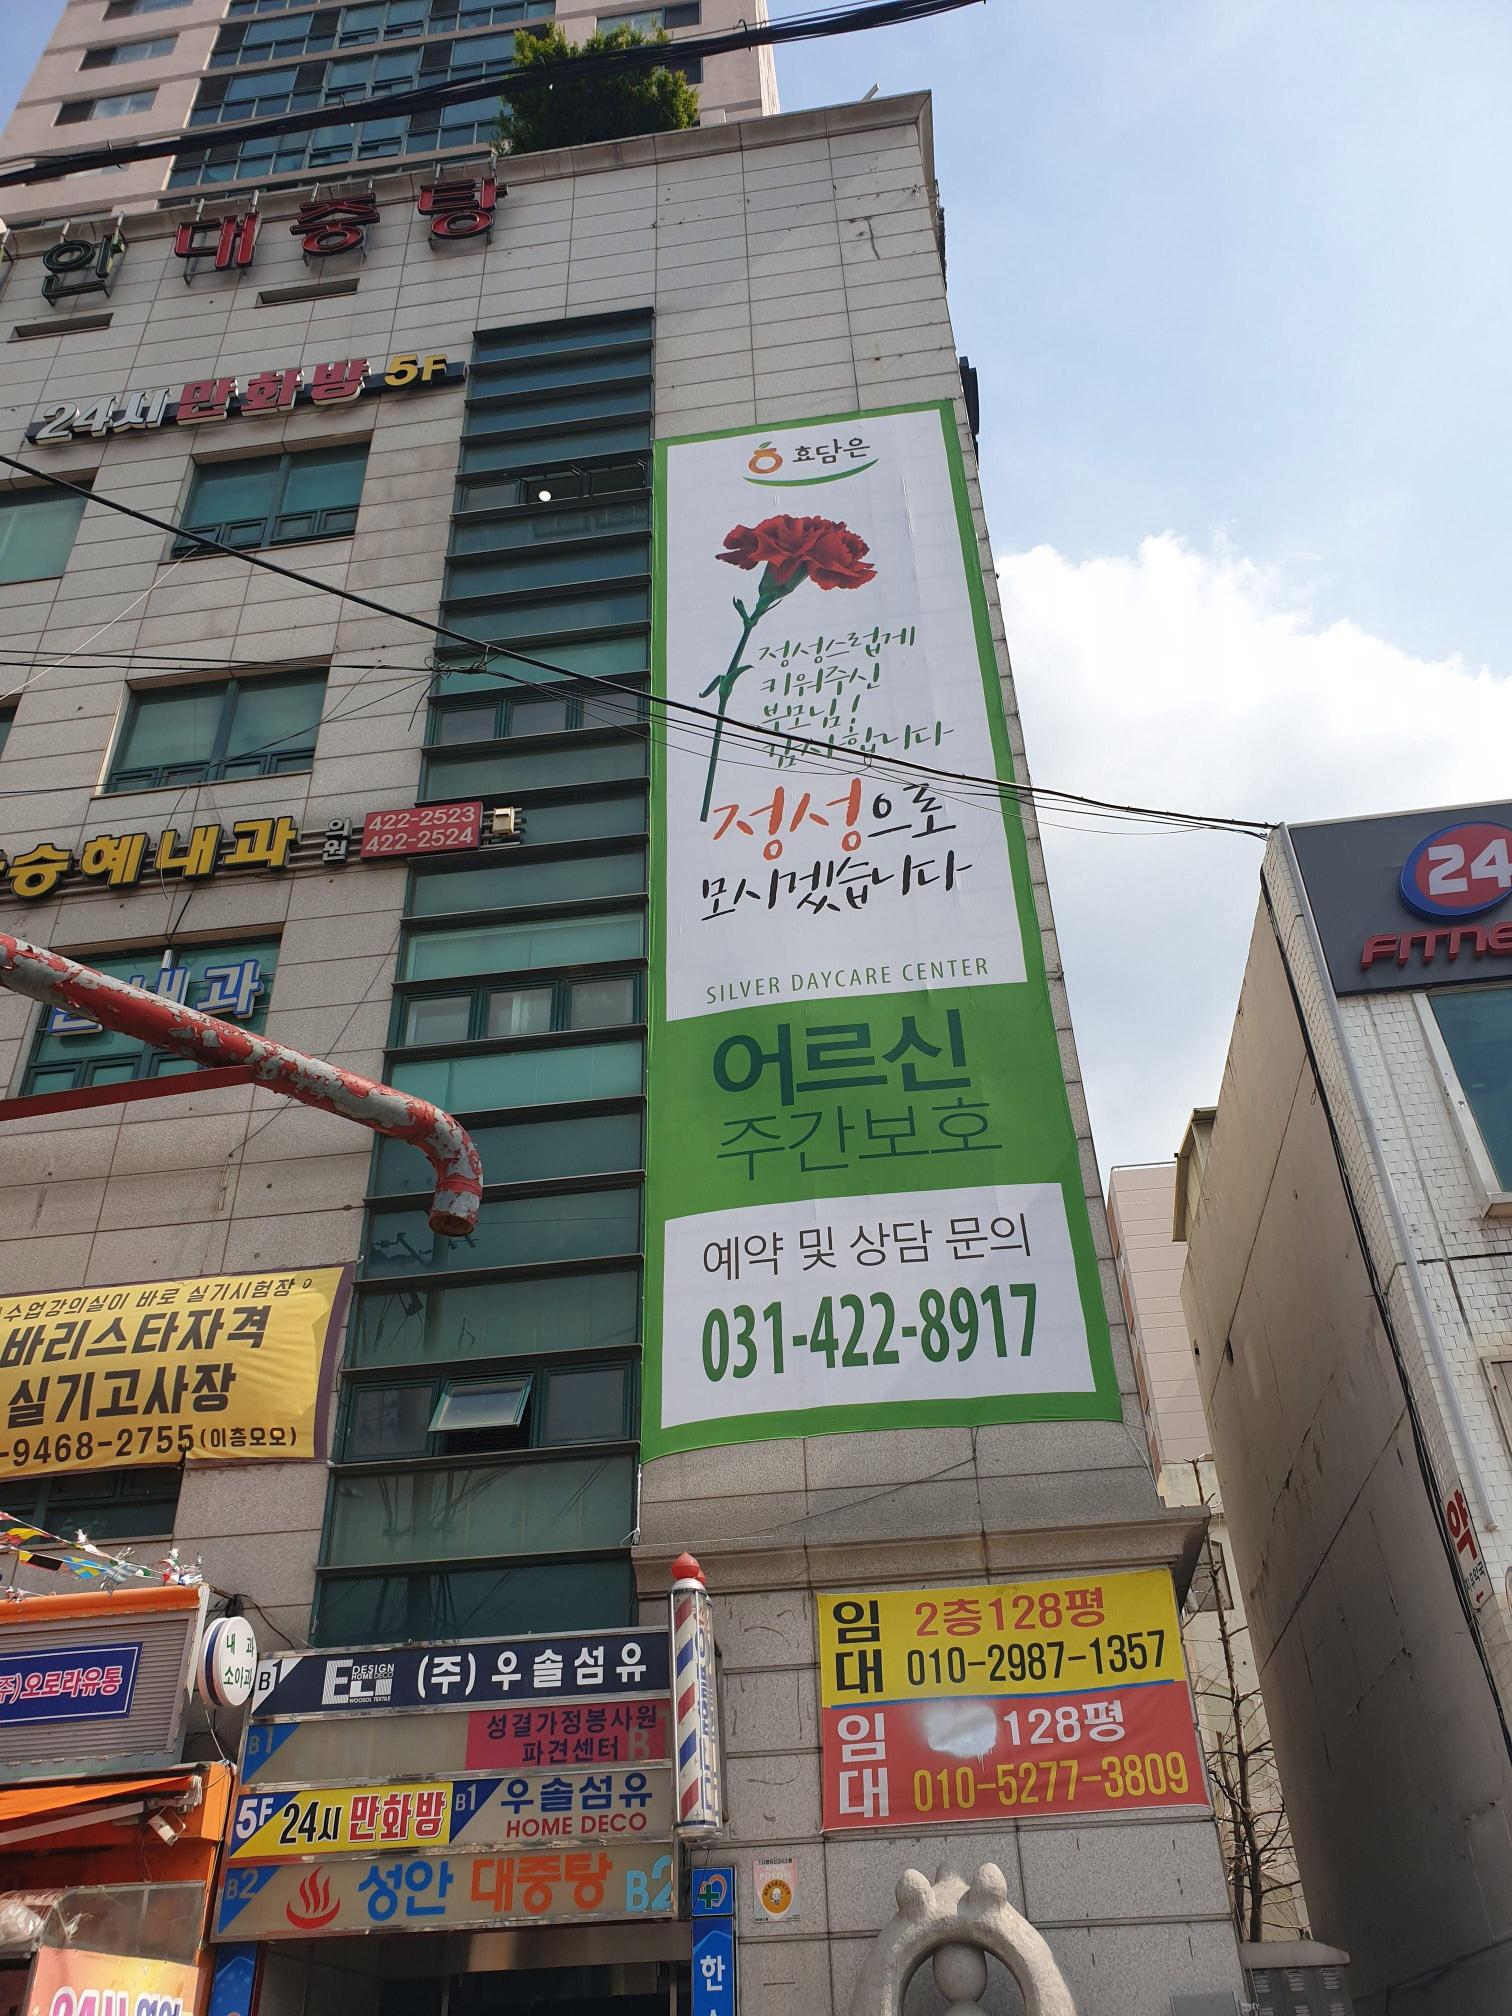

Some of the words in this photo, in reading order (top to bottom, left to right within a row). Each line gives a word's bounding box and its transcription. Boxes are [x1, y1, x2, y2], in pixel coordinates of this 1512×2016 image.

[174, 176, 509, 270] 대중탕
[36, 388, 170, 445] 24시
[177, 358, 372, 426] 만화방
[384, 353, 449, 388] 5F
[792, 437, 871, 465] 효담은
[758, 626, 916, 668] 정성스럽게
[760, 662, 881, 697] 키워주신
[761, 694, 861, 731] 부모님!
[366, 827, 473, 852] 422-2524
[368, 806, 475, 832] 422-2523
[712, 778, 957, 861] 정성으로
[0, 816, 298, 898] 승혜내과
[1428, 838, 1512, 896] 24
[700, 849, 973, 921] 모시겠습니다
[706, 976, 781, 1005] SILVER
[792, 966, 891, 992] DAYCARE
[902, 957, 989, 982] CENTER
[712, 1008, 973, 1107] 어르신
[716, 1097, 1003, 1182] 주간보호
[703, 1231, 784, 1281] 예약
[799, 1227, 838, 1272] 및
[849, 1219, 933, 1267] 상담
[945, 1213, 1032, 1259] 문의
[136, 1287, 180, 1308] 바로
[187, 1278, 296, 1304] 실기시험장
[702, 1282, 1037, 1383] 031-422-8917
[7, 1362, 237, 1429] 실기고사장
[352, 1663, 395, 1675] DESIGN
[417, 1651, 476, 1699] (주)
[491, 1642, 648, 1688] 우솔섬유
[832, 1599, 885, 1695] 임대
[906, 1629, 1166, 1687] 010-2987-1357
[223, 1666, 253, 1689] 소아과
[258, 1659, 283, 1691] B1
[248, 1726, 274, 1755] B1
[486, 1704, 658, 1740] 성결가정봉사원
[1002, 1699, 1126, 1747] 128평
[521, 1735, 619, 1765] 파견센터
[837, 1711, 890, 1818] 임대
[455, 1783, 478, 1812] B1
[500, 1772, 653, 1815] 우솔섬유
[912, 1750, 1190, 1812] 010-5277-3809
[235, 1797, 275, 1840] 5F
[279, 1800, 344, 1846] 24시
[348, 1791, 448, 1843] 만화방
[506, 1816, 573, 1839] HOME
[581, 1812, 647, 1834] DECO
[226, 1867, 259, 1900] B2
[358, 1860, 454, 1922] 성안
[470, 1852, 613, 1914] 대중탕
[625, 1855, 673, 1914] B2
